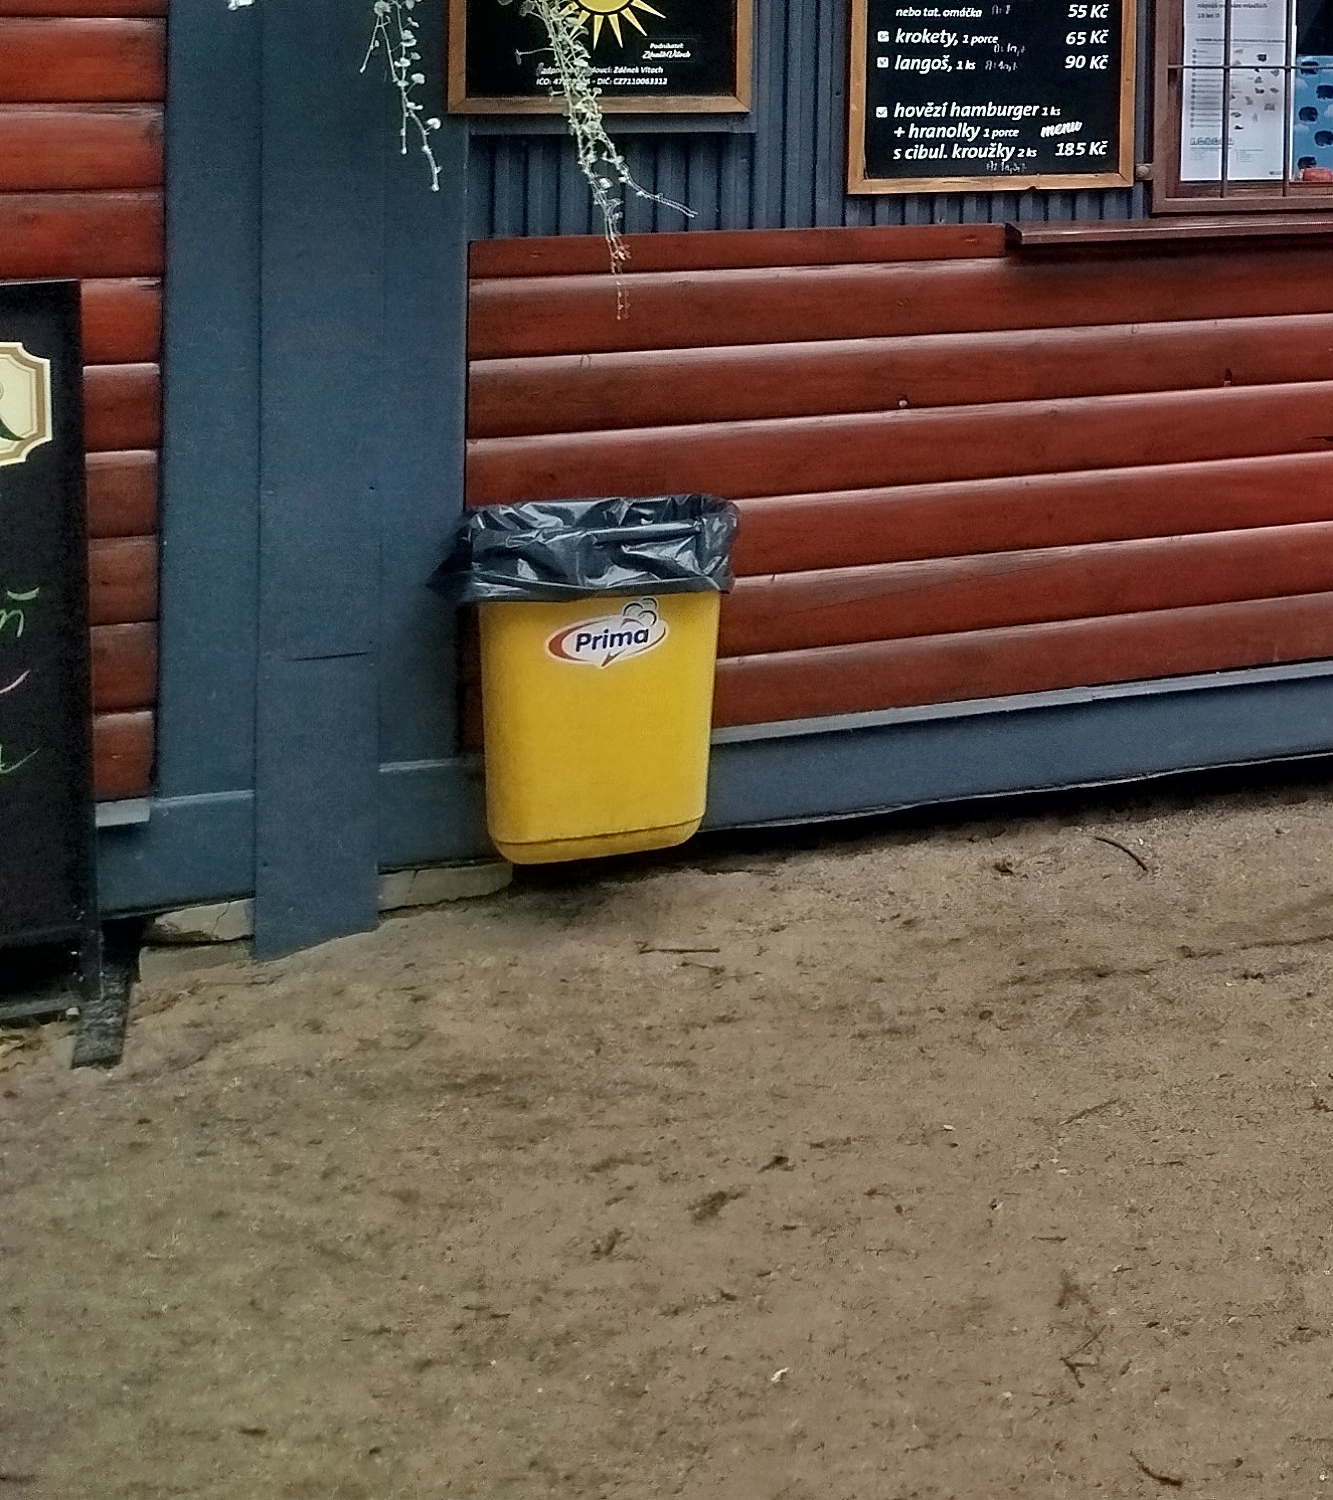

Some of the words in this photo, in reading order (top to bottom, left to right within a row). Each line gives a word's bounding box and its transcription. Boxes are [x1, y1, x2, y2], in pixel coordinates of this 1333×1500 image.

[895, 7, 922, 17] nebo
[923, 8, 941, 17] tat.
[942, 7, 982, 17] omáčka
[895, 28, 958, 48] krokety,
[1066, 32, 1087, 45] 65
[1089, 29, 1109, 44] Kč
[894, 54, 952, 74] langoš,
[893, 102, 948, 118] hovězí
[949, 101, 1040, 121] hamburger
[908, 122, 981, 142] hranolky
[1040, 121, 1083, 138] menu
[904, 143, 948, 159] cibul.
[951, 142, 1015, 164] kroužky
[1055, 142, 1087, 156] 185
[1089, 140, 1108, 155] Kč
[576, 626, 650, 654] Prima
